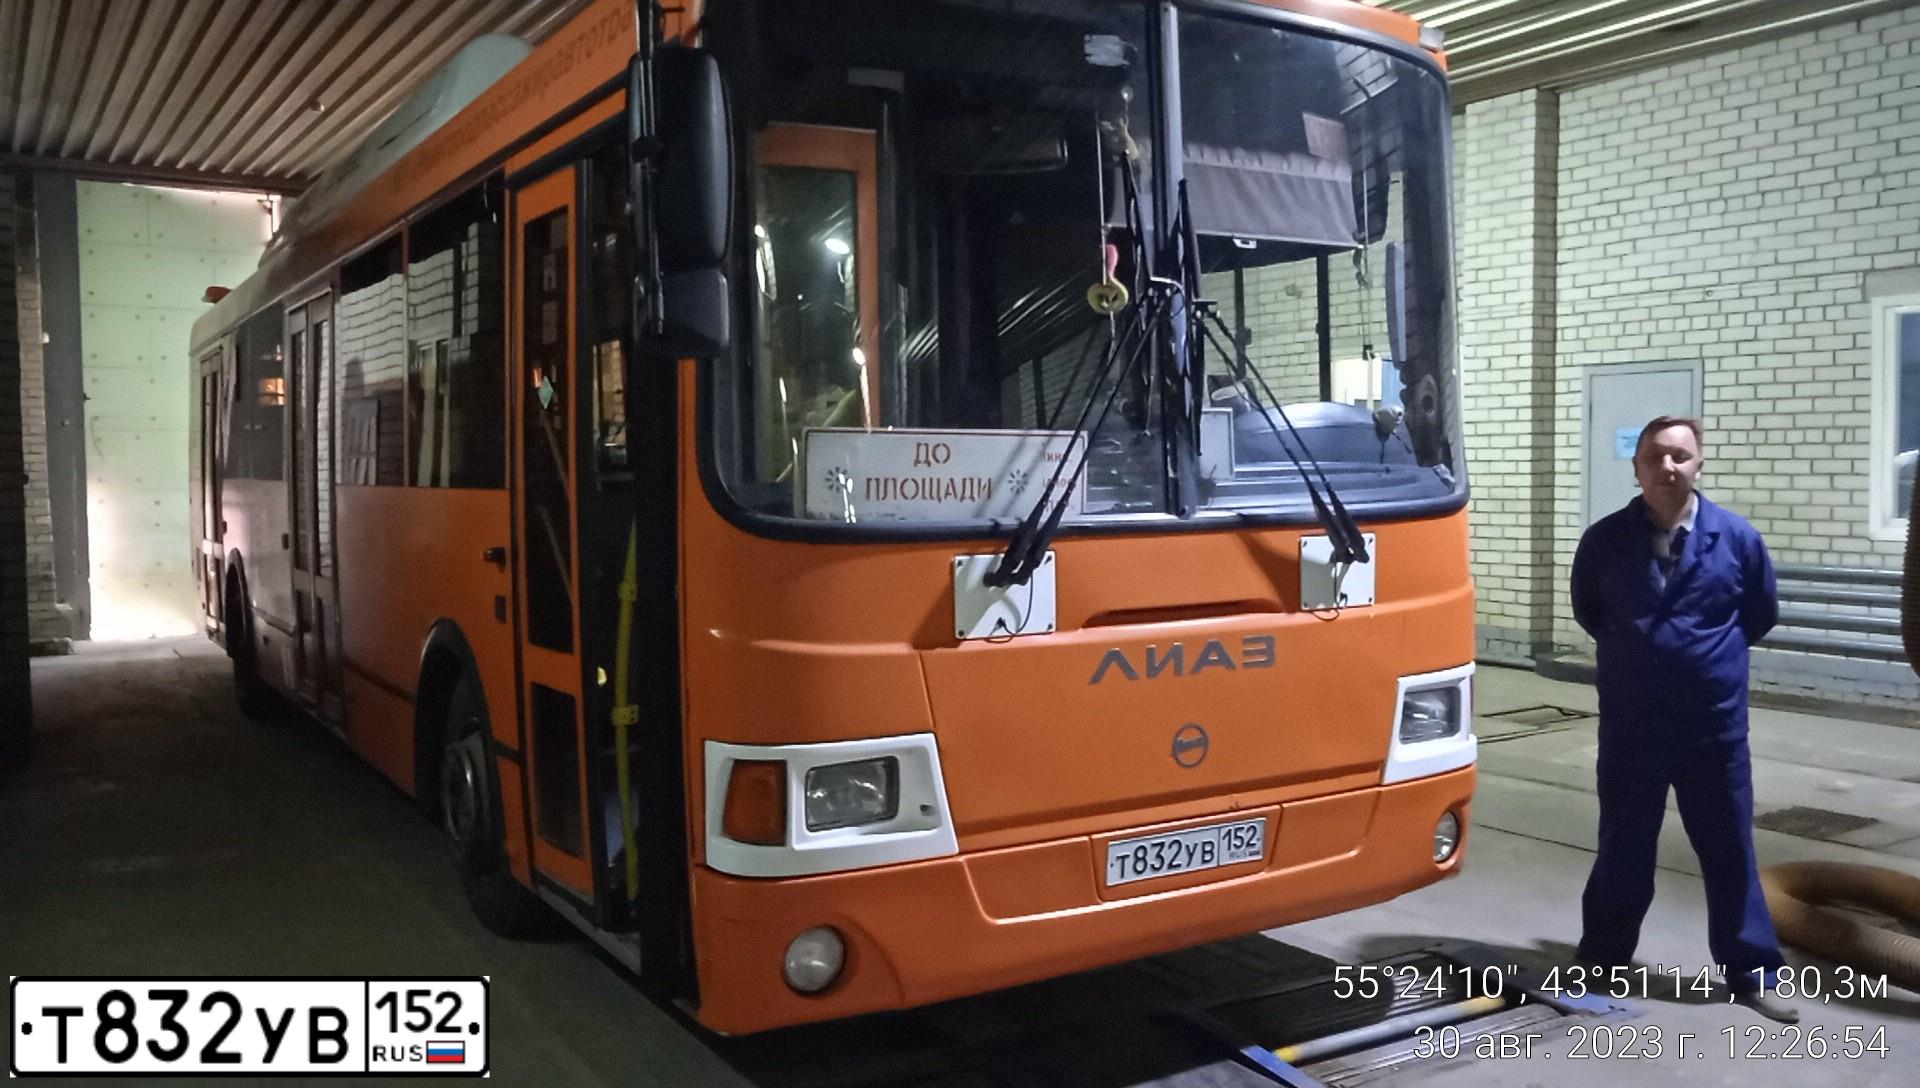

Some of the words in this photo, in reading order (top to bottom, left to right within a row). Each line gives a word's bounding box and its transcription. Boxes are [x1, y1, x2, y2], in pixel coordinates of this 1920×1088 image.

[913, 442, 951, 468] ДО
[865, 476, 992, 503] ПЛОЩАДИ
[1089, 635, 1276, 685] ЛИАЗ
[1222, 824, 1258, 851] 152
